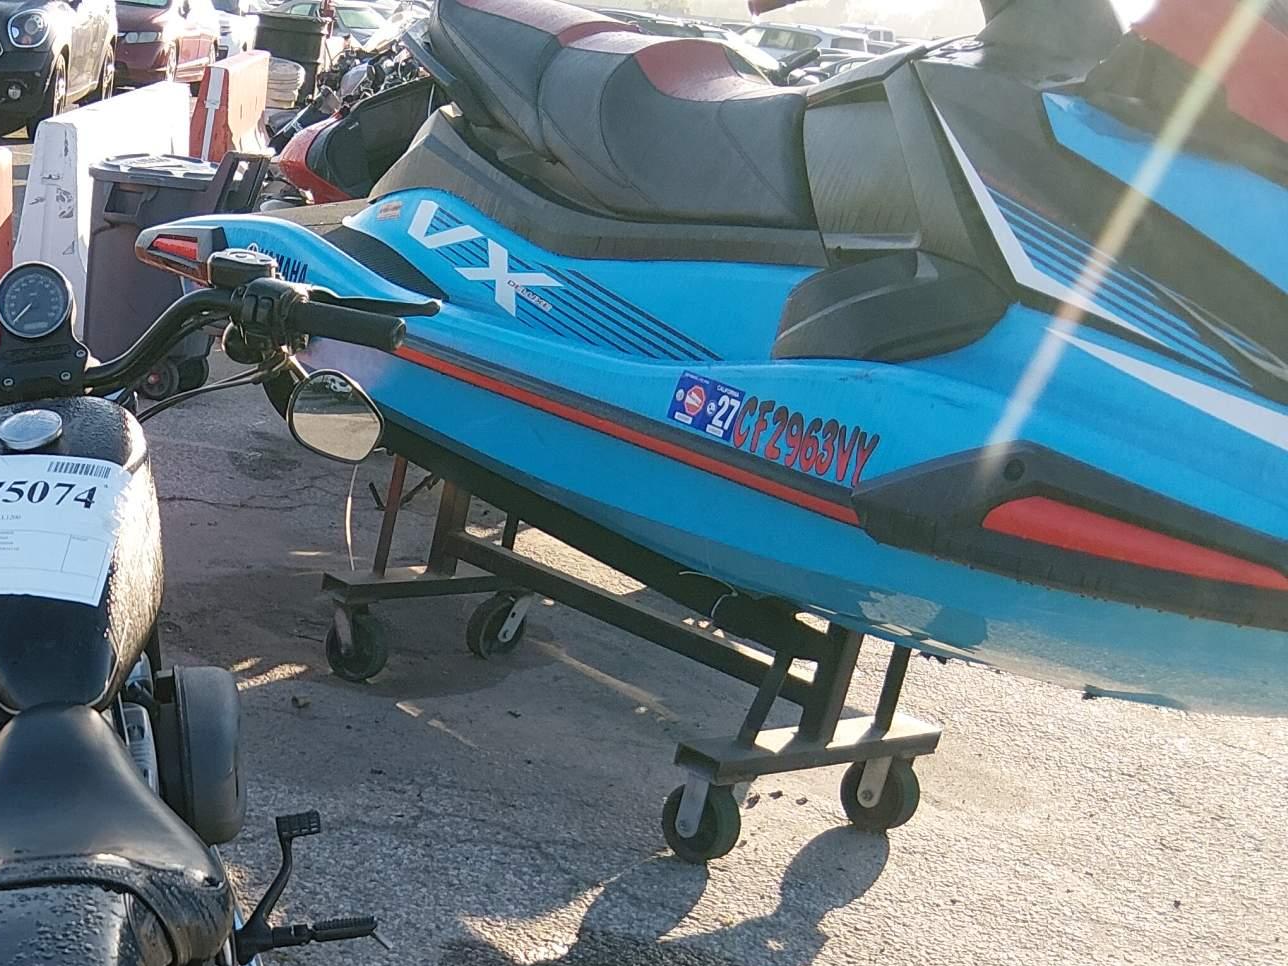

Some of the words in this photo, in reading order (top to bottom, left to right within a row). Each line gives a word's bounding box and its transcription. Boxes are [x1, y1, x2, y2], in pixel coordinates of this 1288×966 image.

[408, 199, 563, 317] VX
[711, 394, 741, 431] 27
[733, 395, 880, 488] CF2963VY
